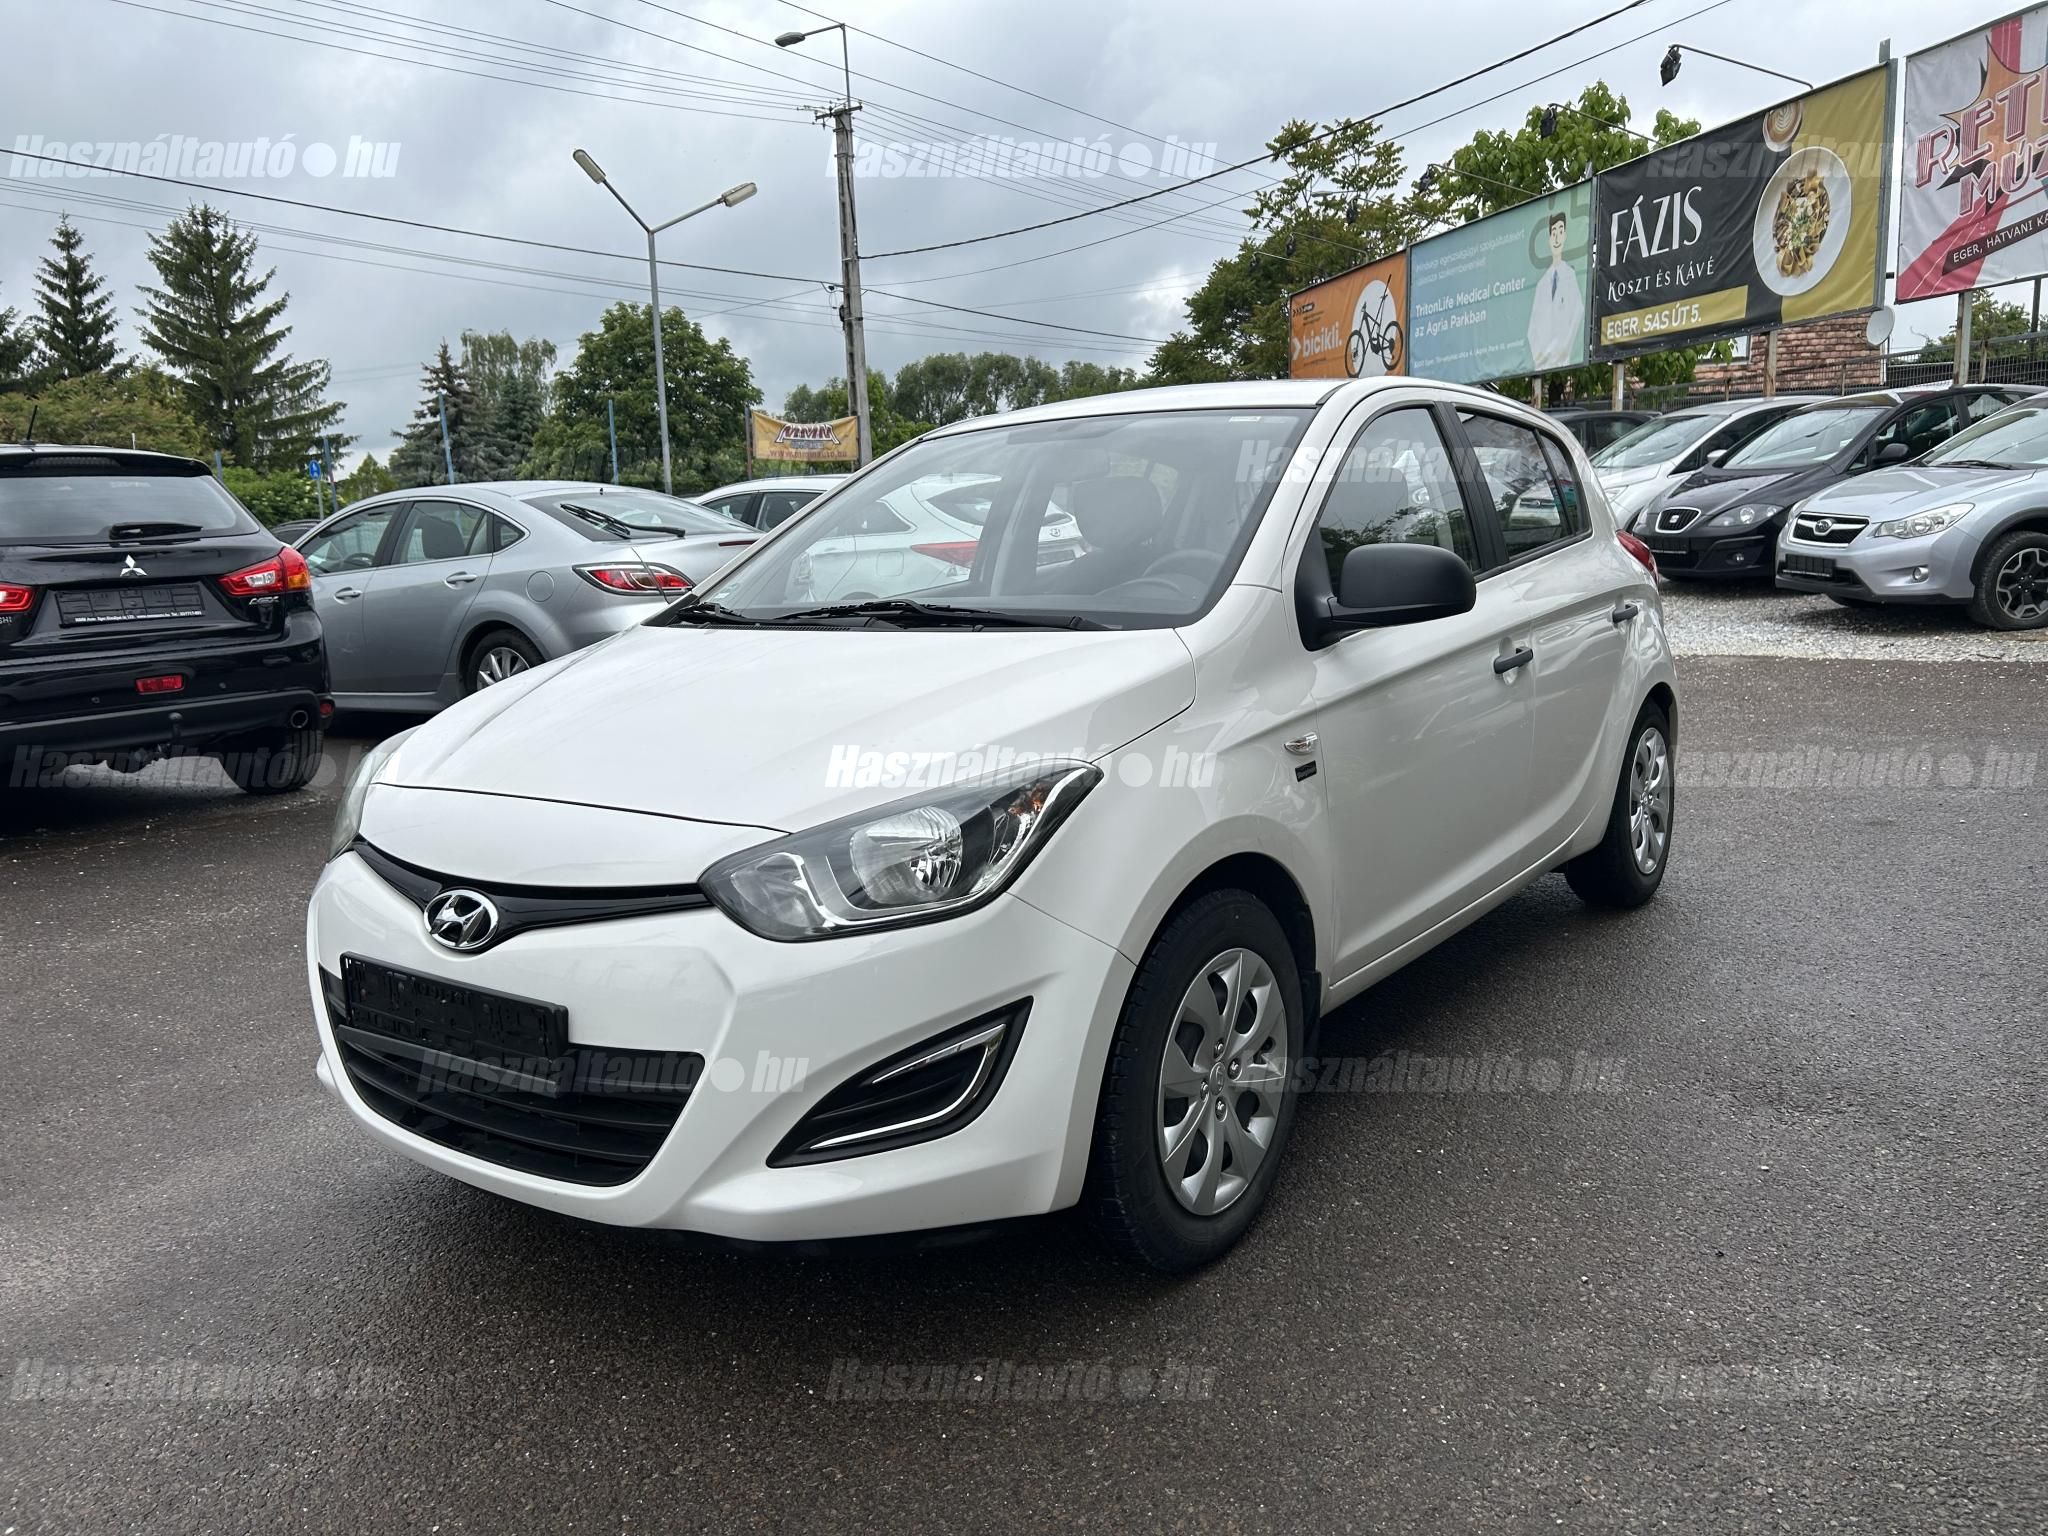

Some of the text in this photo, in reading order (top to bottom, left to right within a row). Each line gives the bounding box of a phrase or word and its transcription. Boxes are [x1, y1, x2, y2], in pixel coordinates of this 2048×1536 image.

[1915, 66, 2048, 188] RET
[1609, 186, 1702, 267] FÁZIS
[1953, 244, 1983, 263] EGER,
[1986, 219, 2032, 249] HATVANI
[1415, 277, 1526, 318] TritonLife Medical Center
[1608, 256, 1715, 302] KOSZT ÉS KÁVÉ
[1415, 310, 1486, 337] az Agria Parkban
[1607, 303, 1702, 340] EGER, SAS ÚT 5.
